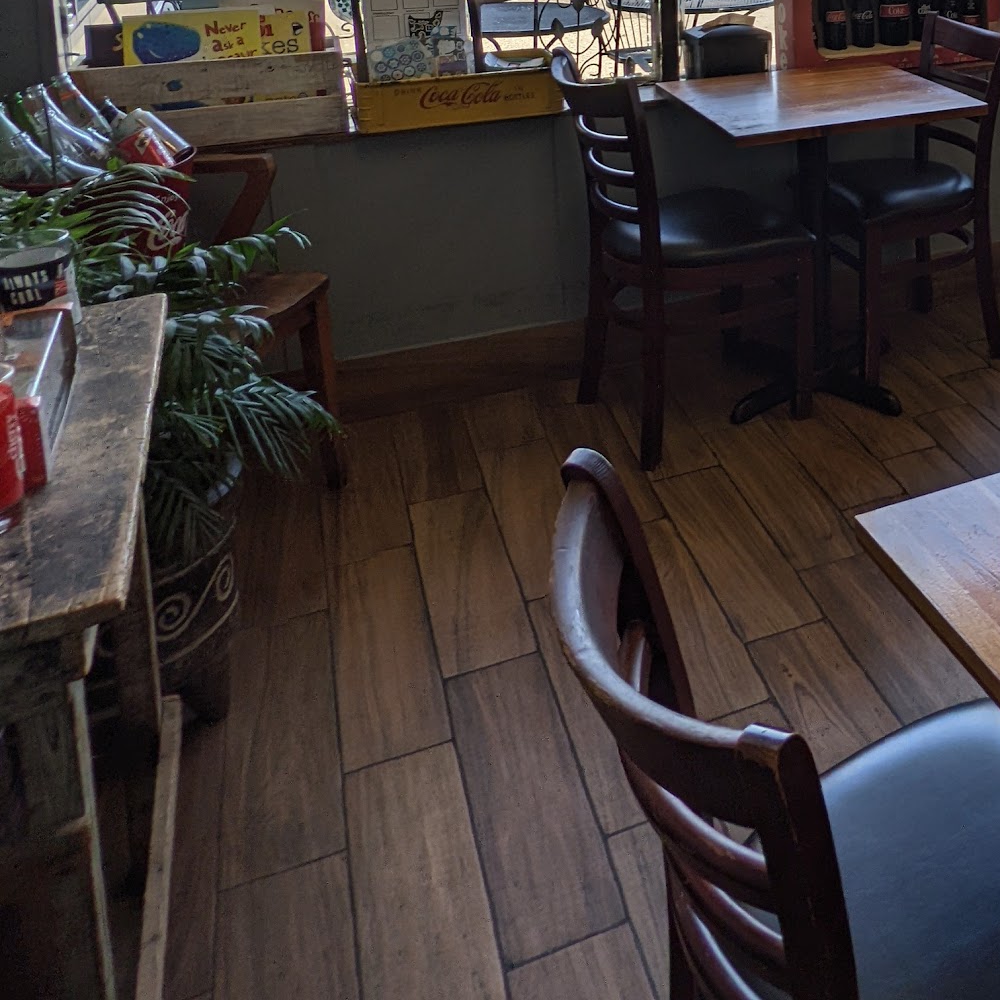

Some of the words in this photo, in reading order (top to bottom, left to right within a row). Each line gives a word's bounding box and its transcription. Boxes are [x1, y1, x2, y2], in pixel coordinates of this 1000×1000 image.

[203, 20, 247, 37] Never
[211, 39, 234, 52] ask
[236, 36, 245, 46] a
